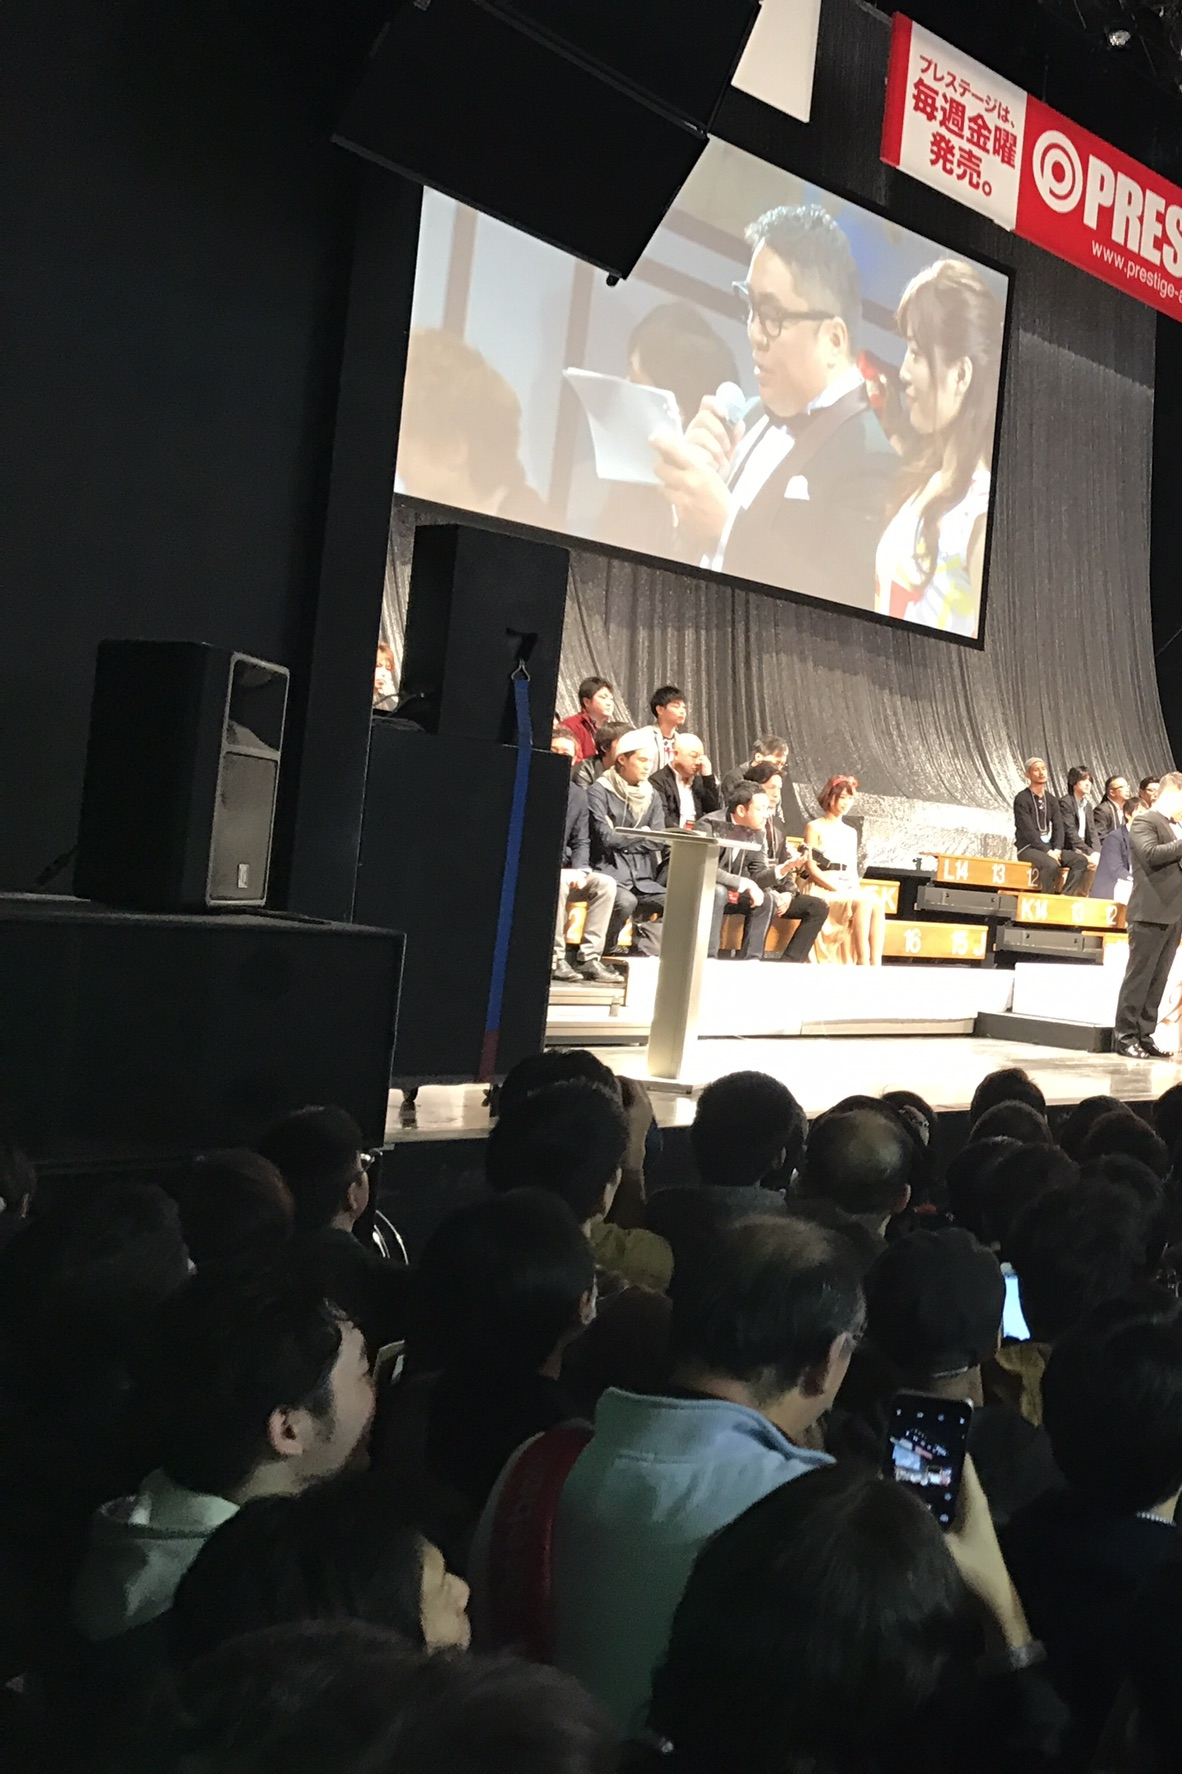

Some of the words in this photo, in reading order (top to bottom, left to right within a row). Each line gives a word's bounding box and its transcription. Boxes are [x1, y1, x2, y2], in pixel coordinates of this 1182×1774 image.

[912, 78, 1018, 169] 毎週金曜
[919, 54, 1016, 129] プレステージは、
[929, 131, 993, 196] 発売。
